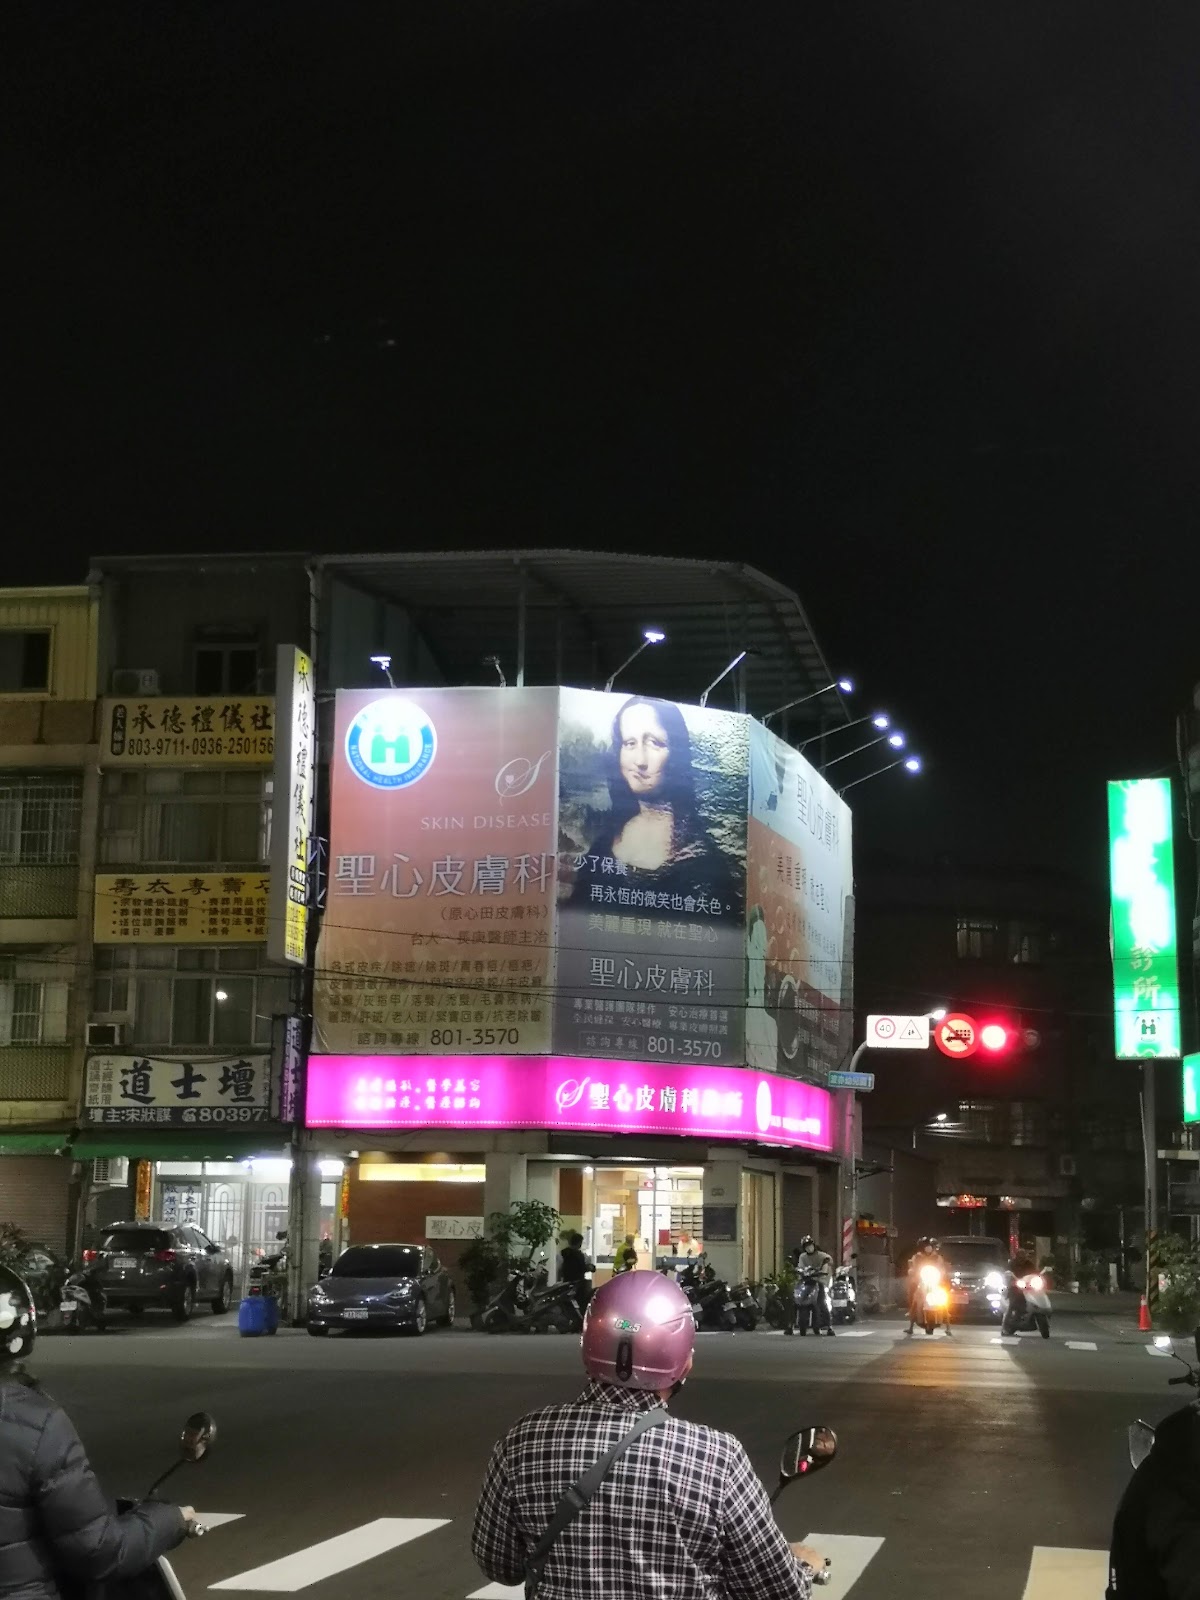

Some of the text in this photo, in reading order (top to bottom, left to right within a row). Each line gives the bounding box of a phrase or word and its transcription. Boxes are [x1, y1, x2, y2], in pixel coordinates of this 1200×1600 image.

[132, 703, 273, 734] 承德禮儀社
[421, 813, 551, 830] SKIN DISEASE
[334, 852, 551, 898] 聖心皮膚科
[590, 884, 731, 915] 再永恆的微笑也會失色。
[588, 913, 718, 943] 美麗重現 就在聖心
[590, 957, 716, 996] 聖心皮膚科
[430, 1027, 519, 1046] 801-3570
[879, 1024, 891, 1032] 40
[647, 1036, 722, 1059] 801-3570
[119, 1059, 256, 1104] 道士壇
